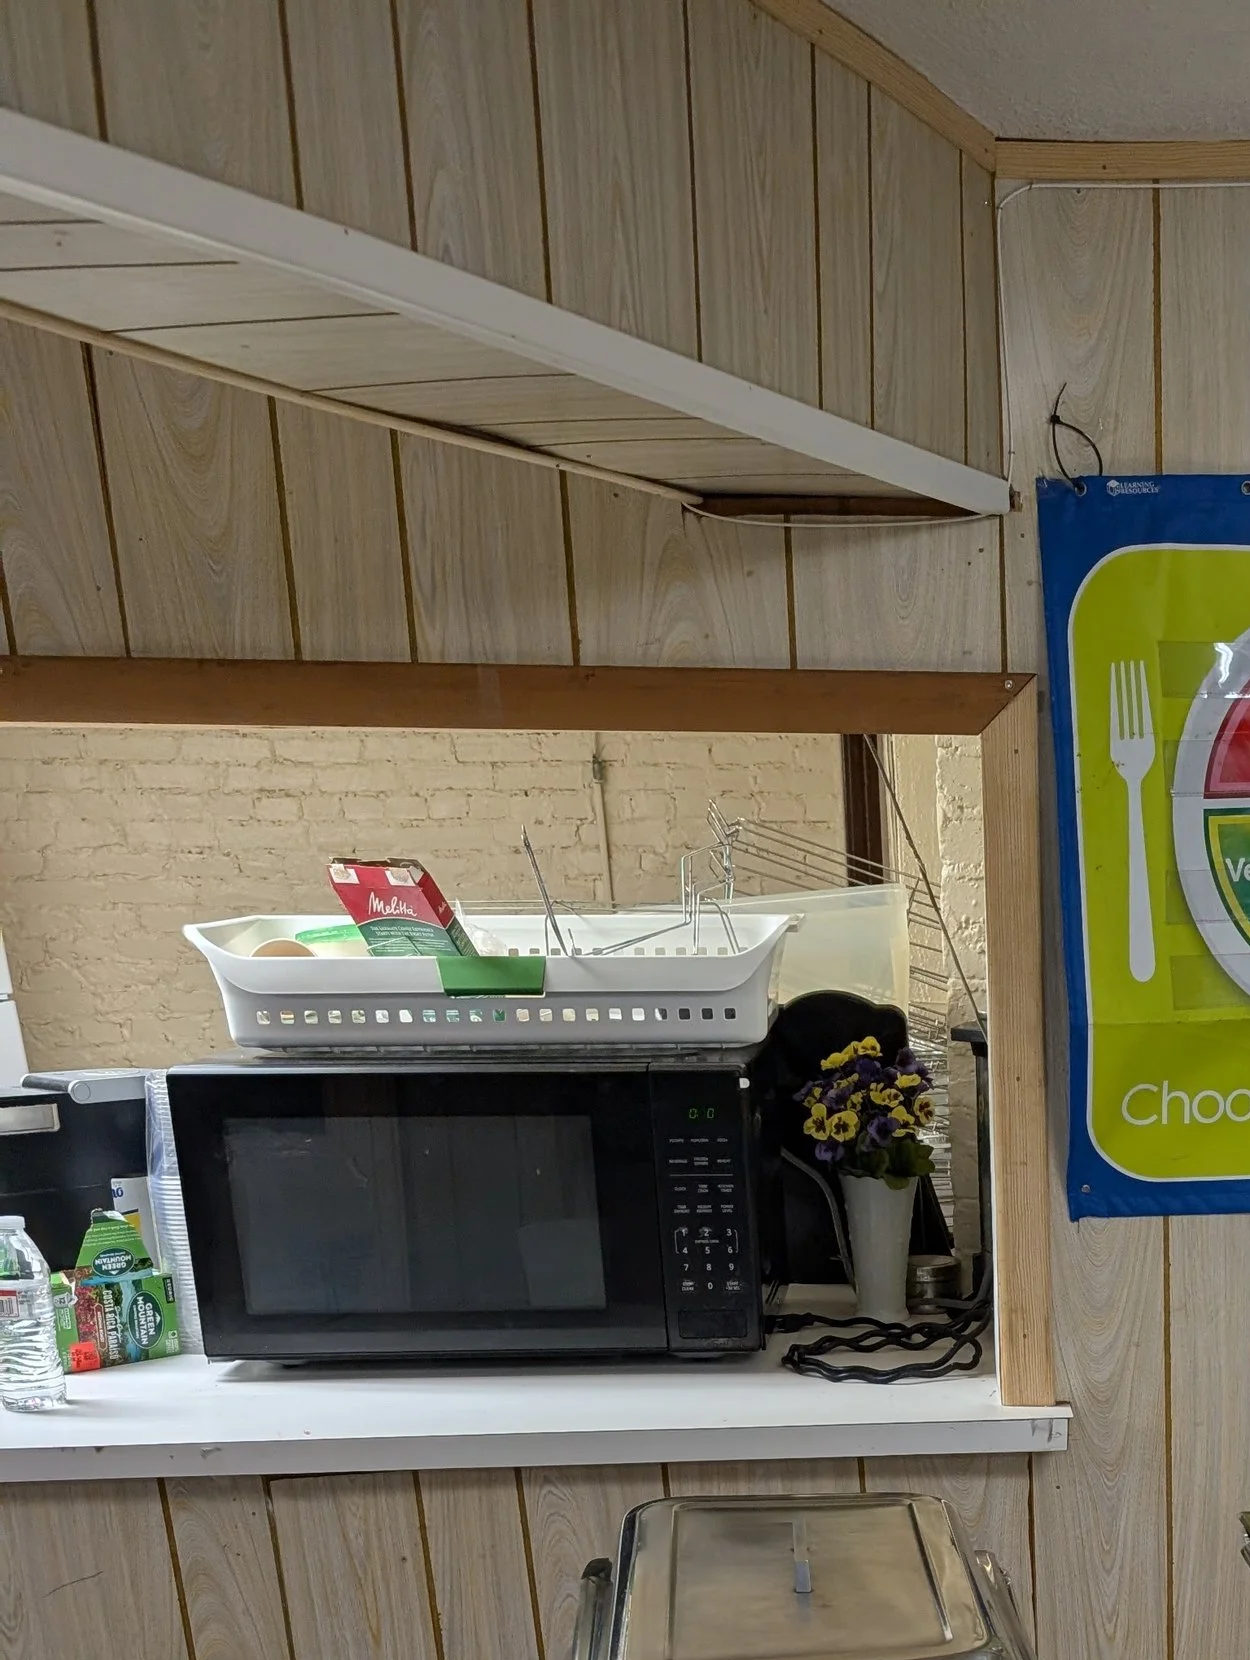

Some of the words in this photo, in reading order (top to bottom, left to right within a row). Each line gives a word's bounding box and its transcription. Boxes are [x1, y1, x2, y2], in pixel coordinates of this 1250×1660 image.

[368, 891, 417, 918] Melitta
[726, 1228, 733, 1237] 3
[682, 1246, 689, 1254] 4
[705, 1246, 711, 1254] 5
[727, 1246, 734, 1254] 6
[95, 1254, 132, 1265] MOUNTAIN
[102, 1262, 127, 1271] GREEN
[683, 1263, 689, 1271] 7
[706, 1263, 712, 1271] 8
[728, 1263, 735, 1271] 9
[707, 1281, 714, 1290] 0
[103, 1289, 114, 1312] COSTA
[107, 1313, 117, 1331] RICA
[137, 1296, 149, 1346] MOUNTAIN
[145, 1303, 156, 1336] GREEN
